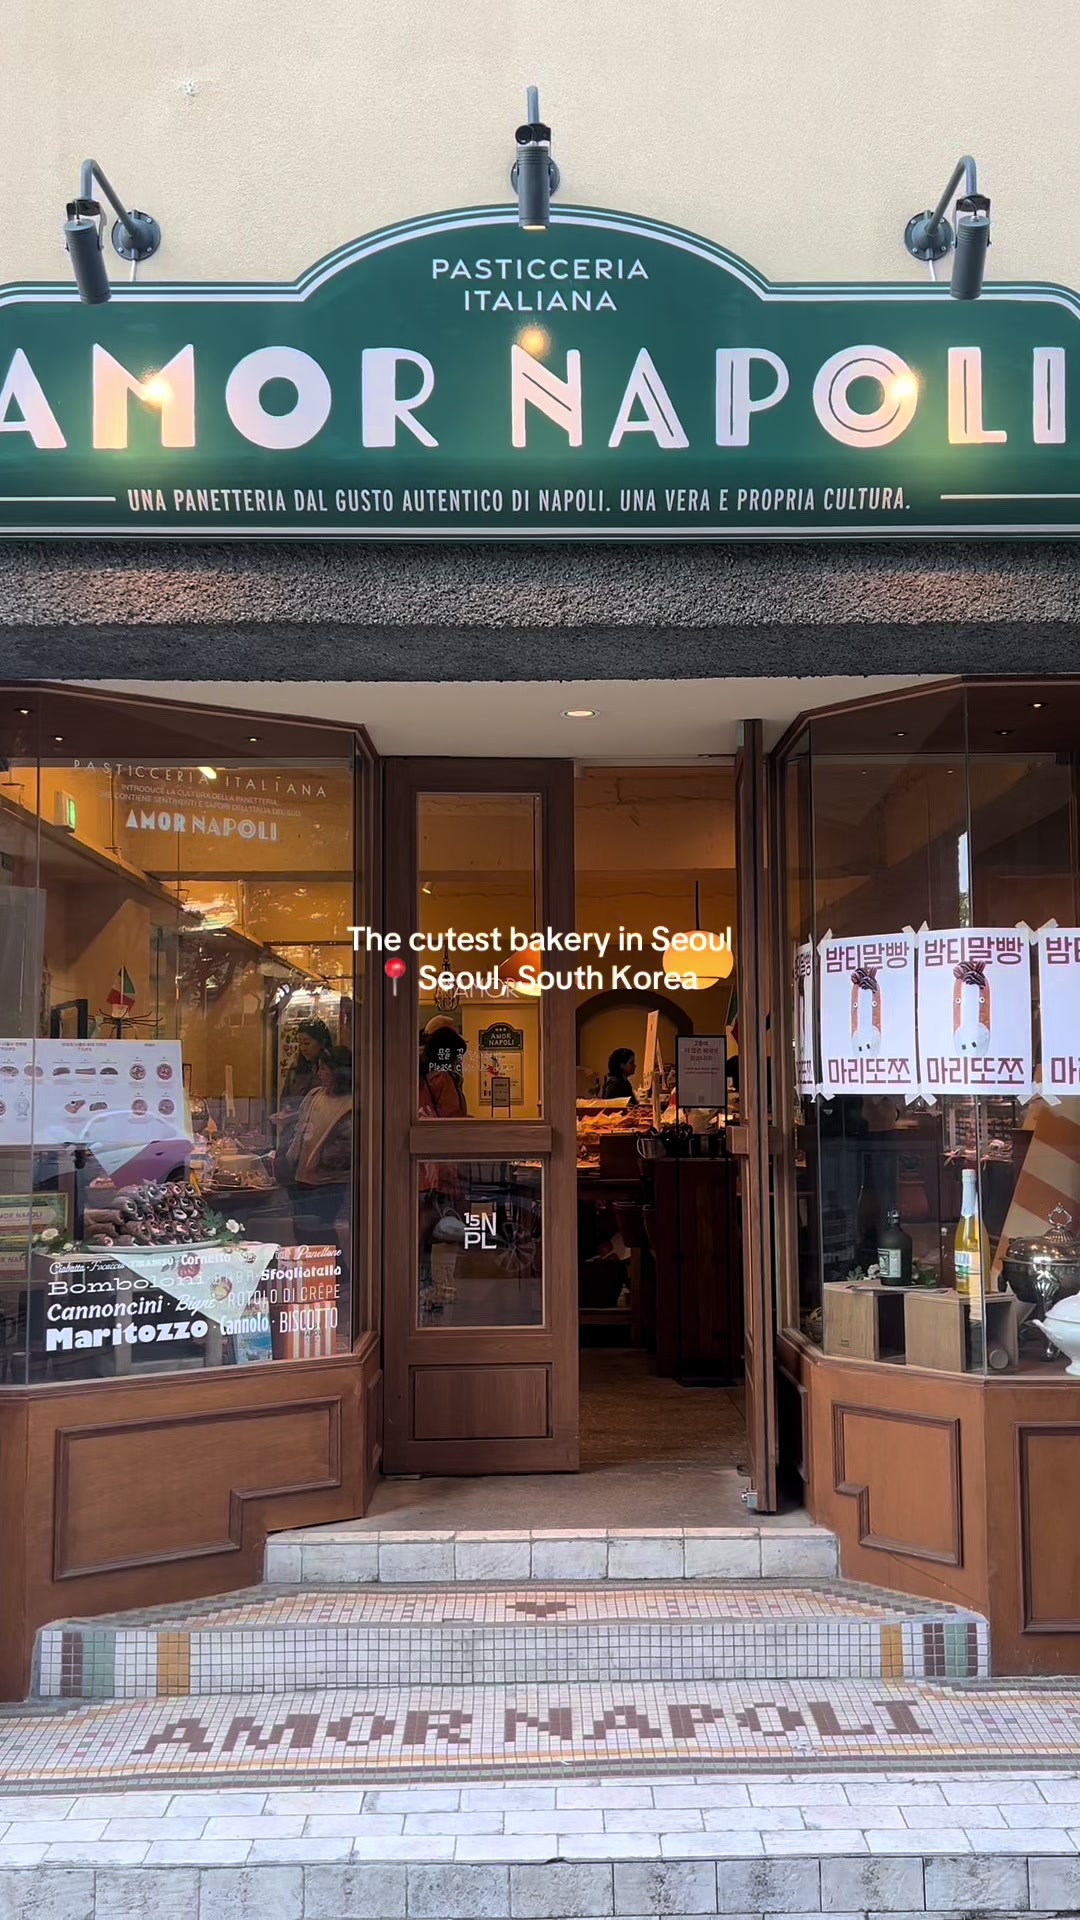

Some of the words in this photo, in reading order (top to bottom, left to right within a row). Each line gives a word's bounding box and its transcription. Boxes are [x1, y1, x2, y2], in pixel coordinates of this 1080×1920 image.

[431, 258, 650, 280] PASTICCERIA
[464, 290, 618, 311] ITALIANA
[0, 343, 439, 449] AMOR
[511, 344, 1067, 449] NAPOLI
[127, 488, 167, 512] UNA
[174, 488, 287, 512] PANETTERIA
[294, 489, 328, 512] DAL
[335, 489, 394, 512] GUSTO
[402, 489, 503, 512] AUTENTICO
[512, 489, 530, 511] DI
[538, 489, 611, 512] NAPOLI.
[620, 489, 657, 511] UNA
[665, 489, 711, 511] VERA
[719, 489, 728, 511] E
[737, 488, 815, 511] PROPRIA
[823, 487, 911, 510] CULTURA.
[74, 759, 210, 786] PASTICCERIA
[225, 775, 327, 798] ITALIANA
[120, 783, 165, 795] INTRODUCE
[166, 786, 176, 796] LA
[177, 787, 211, 799] CULTURA
[212, 791, 235, 802] DELLA
[125, 809, 186, 832] AMOR
[192, 815, 278, 841] NAPOLI
[825, 941, 910, 974] 밤티말빵
[924, 936, 1025, 967] 밤티말빵
[428, 1062, 453, 1073] Please
[827, 1058, 912, 1084] 마리또쪼
[926, 1056, 1025, 1085] 마리또쪼
[1051, 1055, 1080, 1085] 마
[47, 1272, 205, 1296] Bomboloni
[260, 1265, 342, 1281] Sfogliatella
[47, 1295, 164, 1322] Cannoncini
[228, 1289, 278, 1308] ROTOLO
[283, 1287, 295, 1303] DI
[300, 1282, 341, 1302] CRÊPE
[46, 1320, 209, 1352] Maritozzo
[219, 1311, 269, 1336] Cannolo
[279, 1306, 338, 1334] BISCOTTO
[130, 1709, 472, 1755] AMOR
[504, 1700, 933, 1742] NAPOLI
